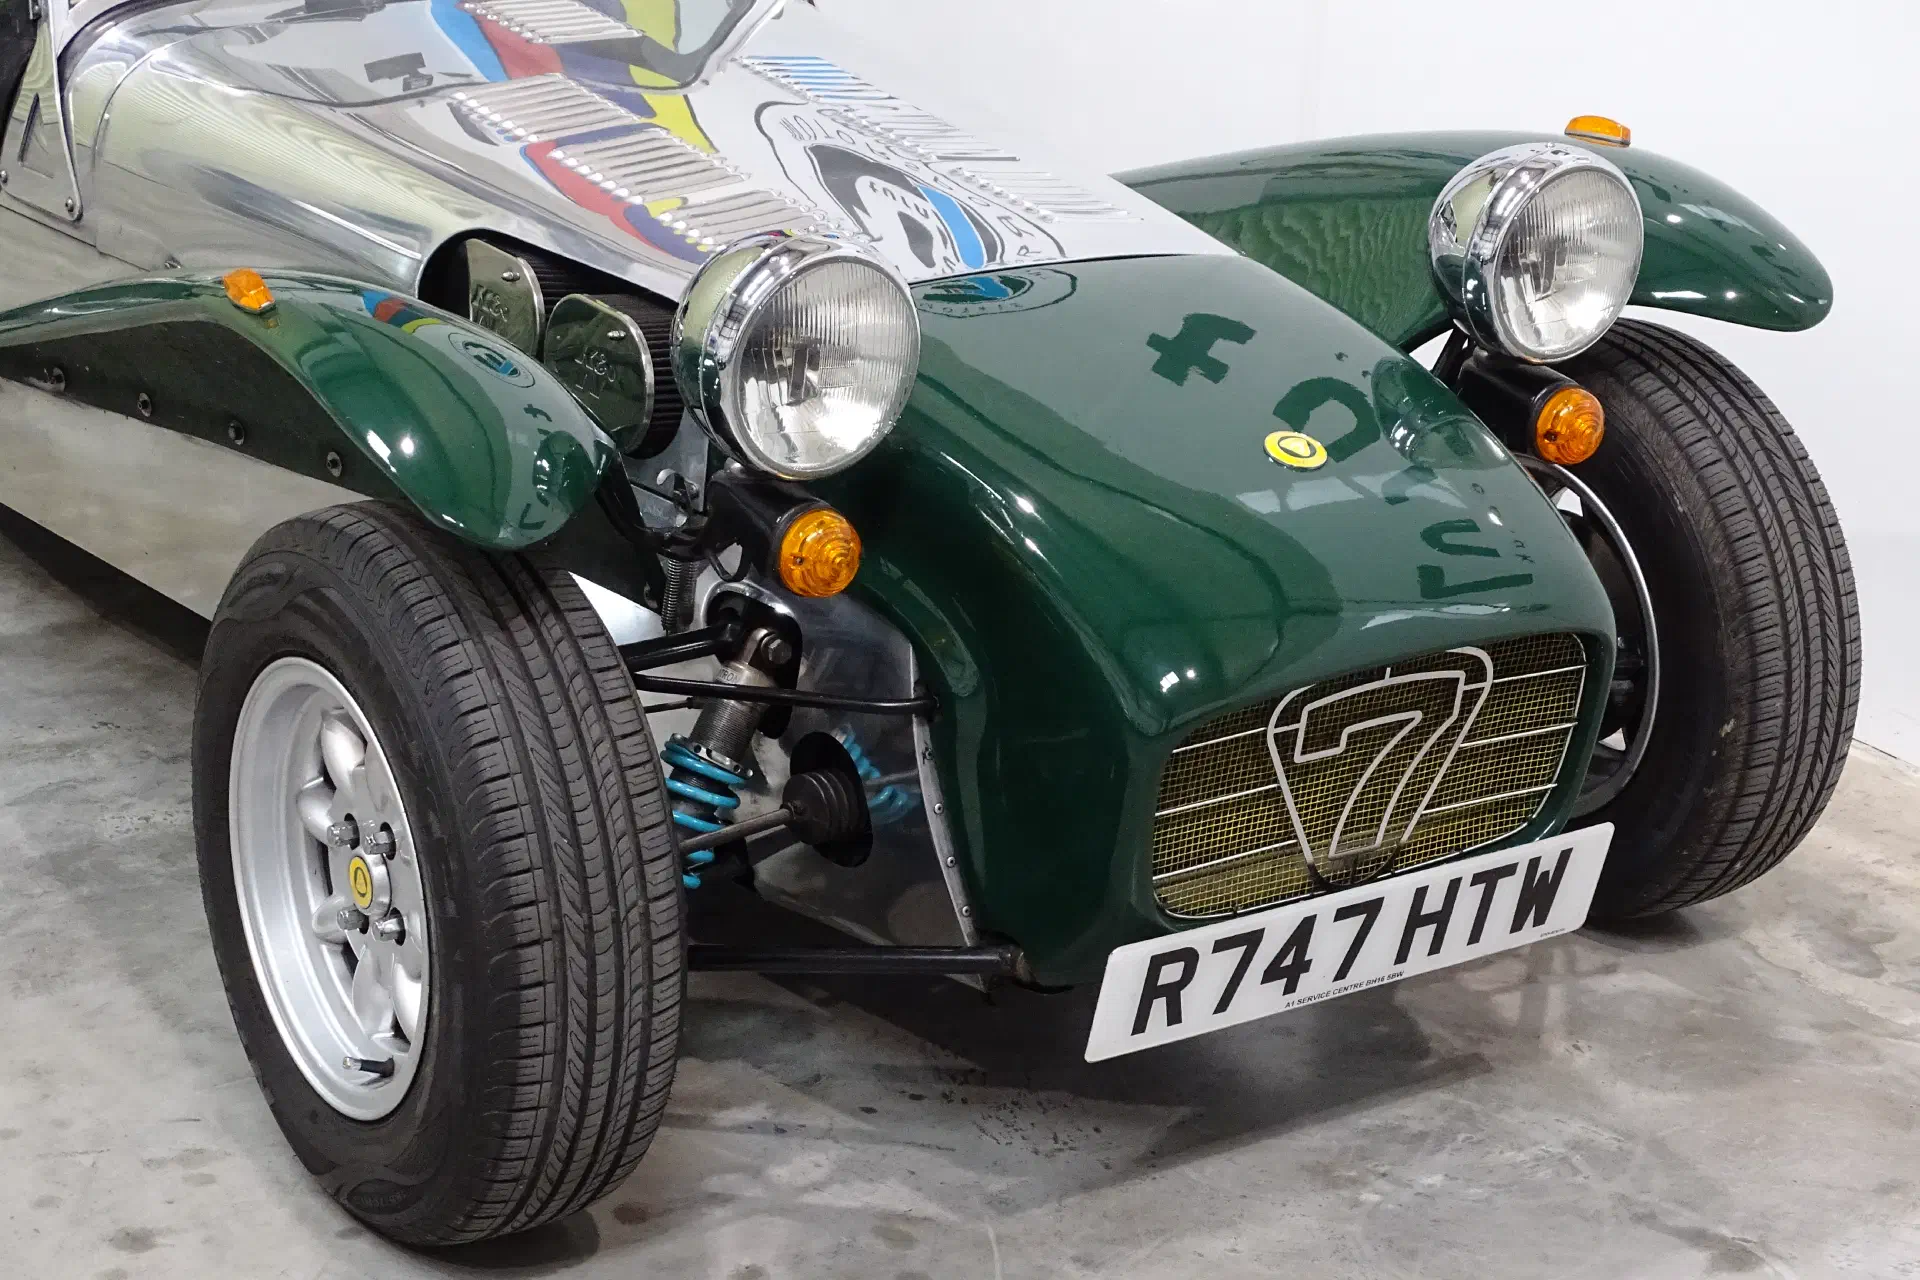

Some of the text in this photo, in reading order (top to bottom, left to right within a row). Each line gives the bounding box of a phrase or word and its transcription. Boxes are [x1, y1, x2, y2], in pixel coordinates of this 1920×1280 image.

[1294, 670, 1467, 861] 7
[1131, 848, 1574, 1036] R747 HTW
[1284, 1000, 1296, 1009] A1
[1297, 990, 1332, 1005] SERVICE
[1332, 981, 1364, 996] CENTRE
[1365, 975, 1385, 987] BH16
